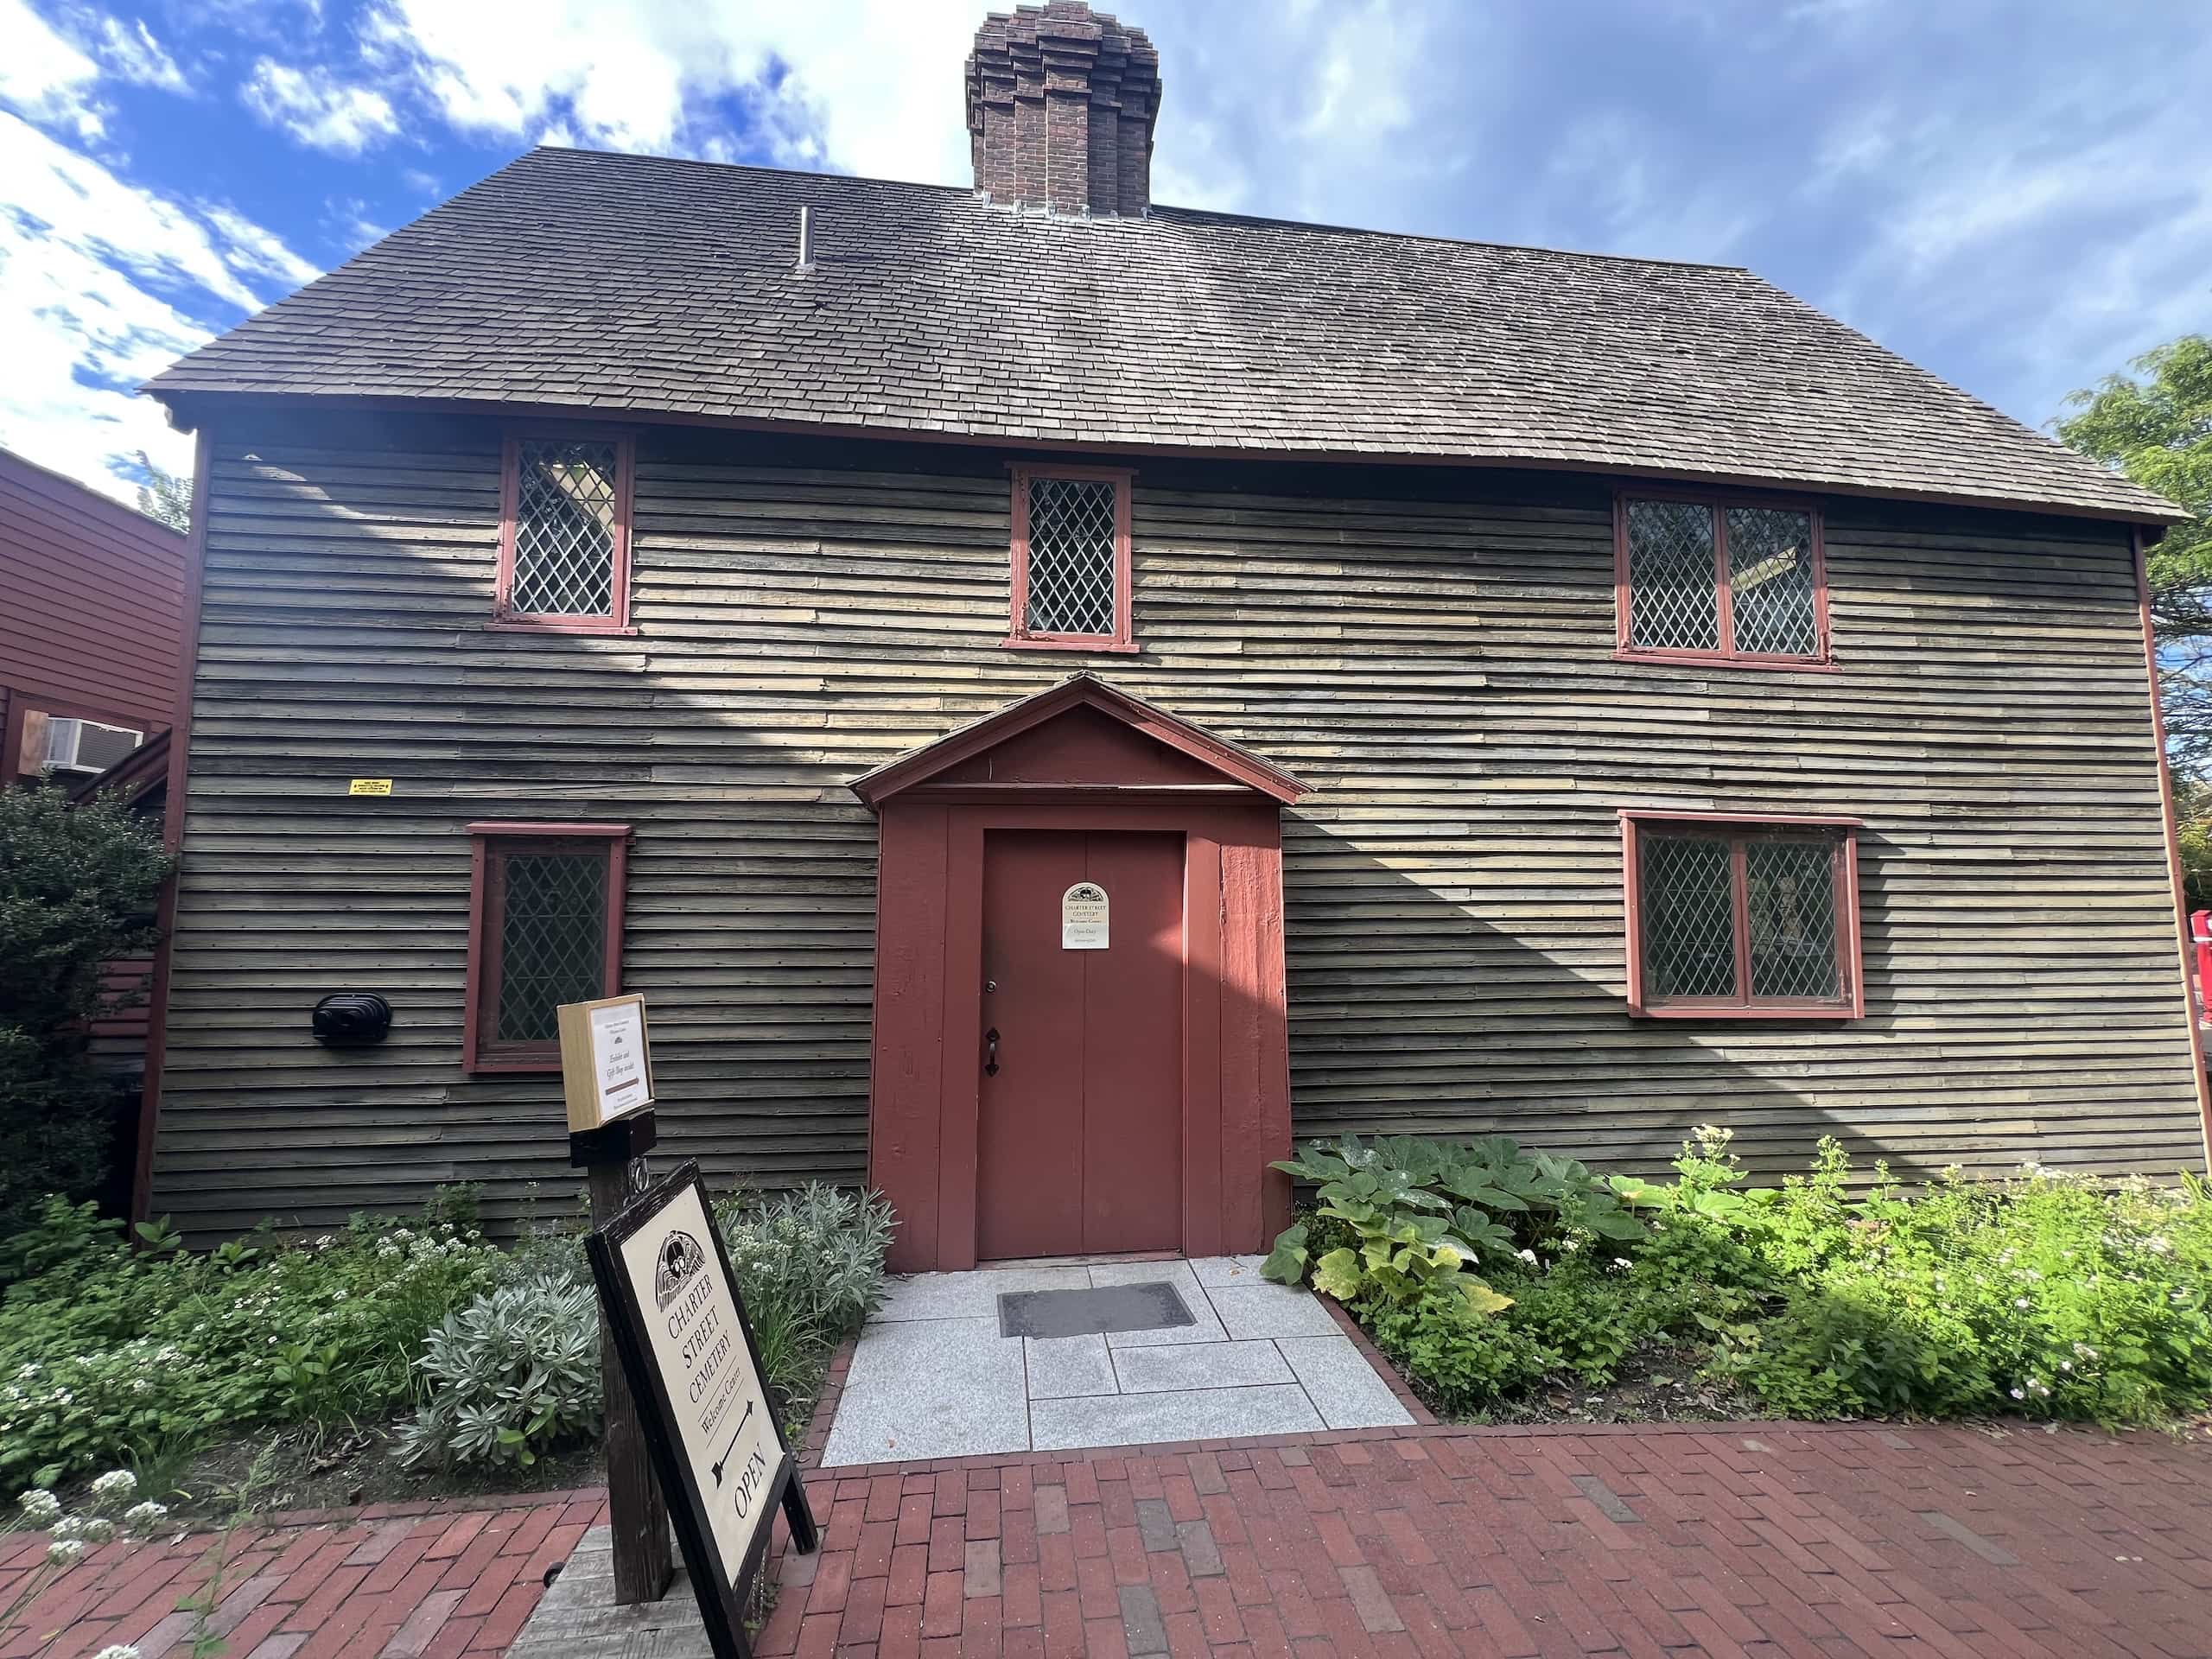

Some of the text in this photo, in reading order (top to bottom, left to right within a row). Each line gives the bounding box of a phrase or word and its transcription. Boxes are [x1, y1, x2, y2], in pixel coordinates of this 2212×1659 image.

[668, 1274, 713, 1339] CHARTER
[682, 1305, 720, 1369] STREET
[689, 1330, 731, 1403] CEMETERY
[701, 1367, 741, 1434] Welcome Center
[734, 1441, 766, 1519] OPEN
